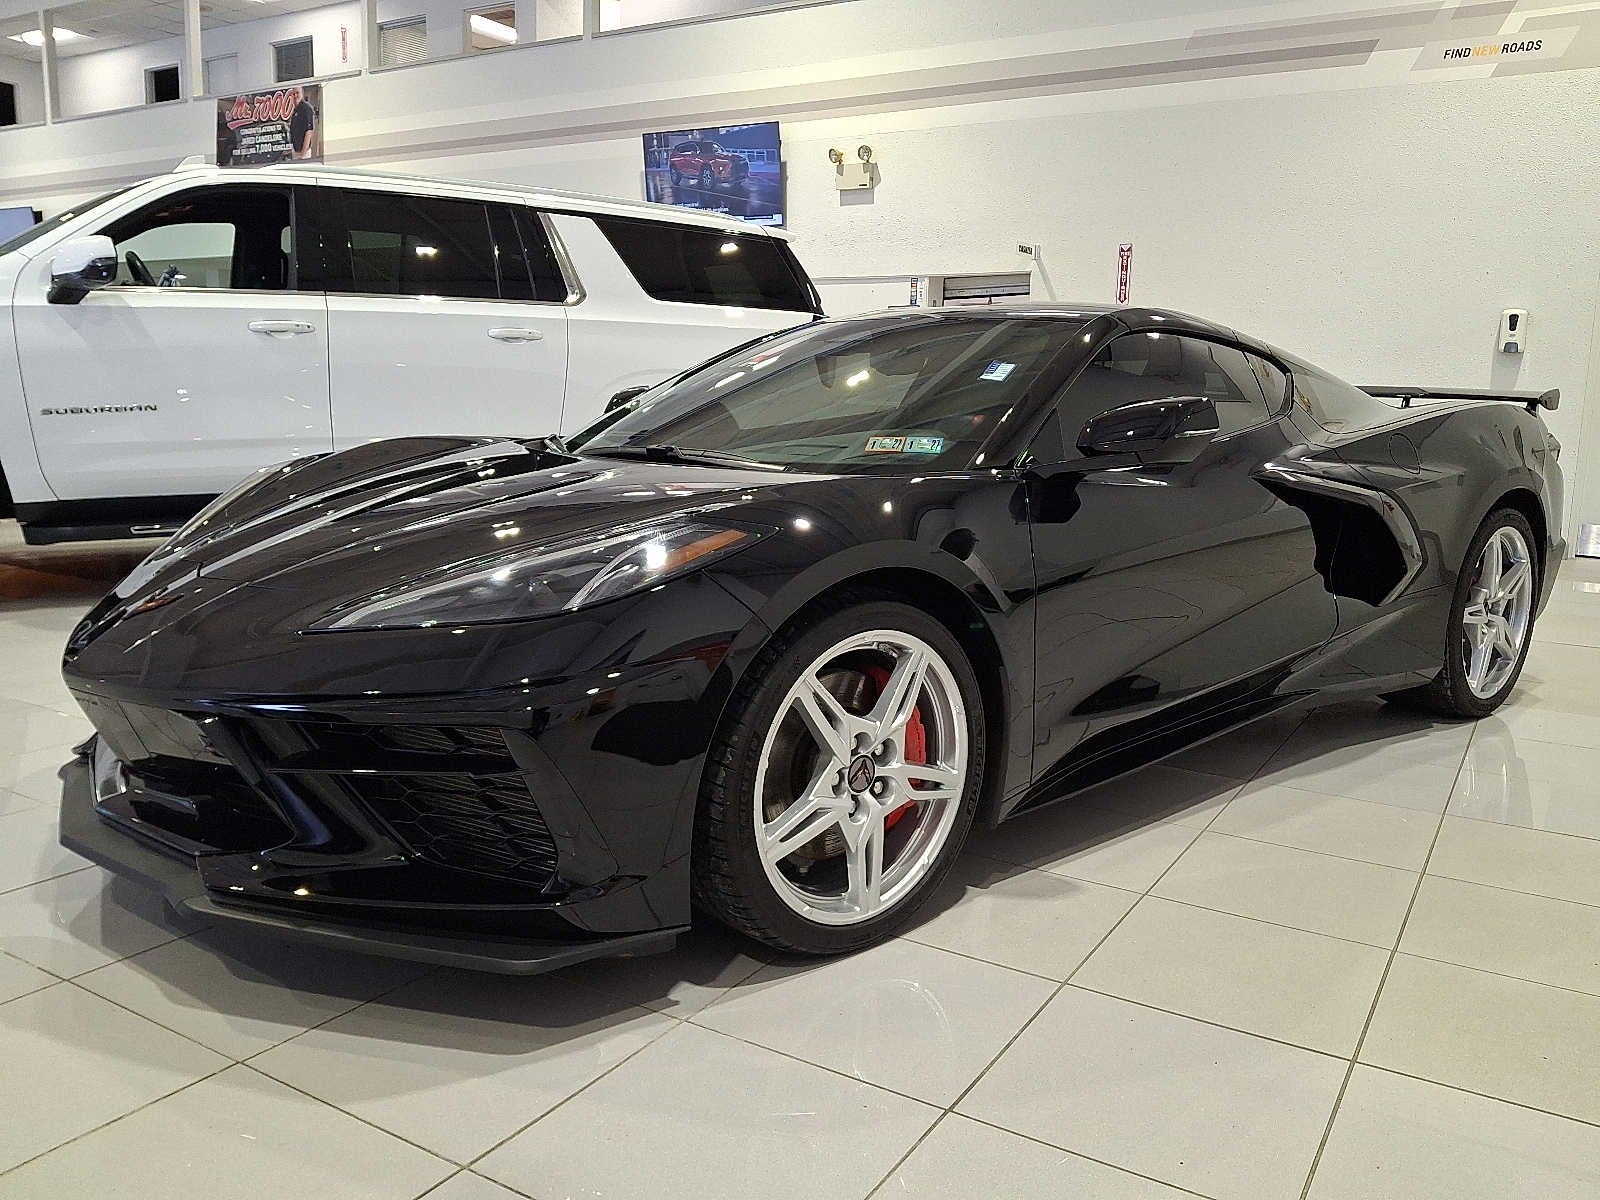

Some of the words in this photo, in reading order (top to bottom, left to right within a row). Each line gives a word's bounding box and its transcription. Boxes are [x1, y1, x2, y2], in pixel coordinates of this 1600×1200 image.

[1443, 47, 1471, 59] FIND
[1472, 44, 1500, 56] NEW
[1501, 39, 1543, 54] ROADS
[253, 88, 297, 121] 7000
[40, 404, 158, 416] SUBURBAN
